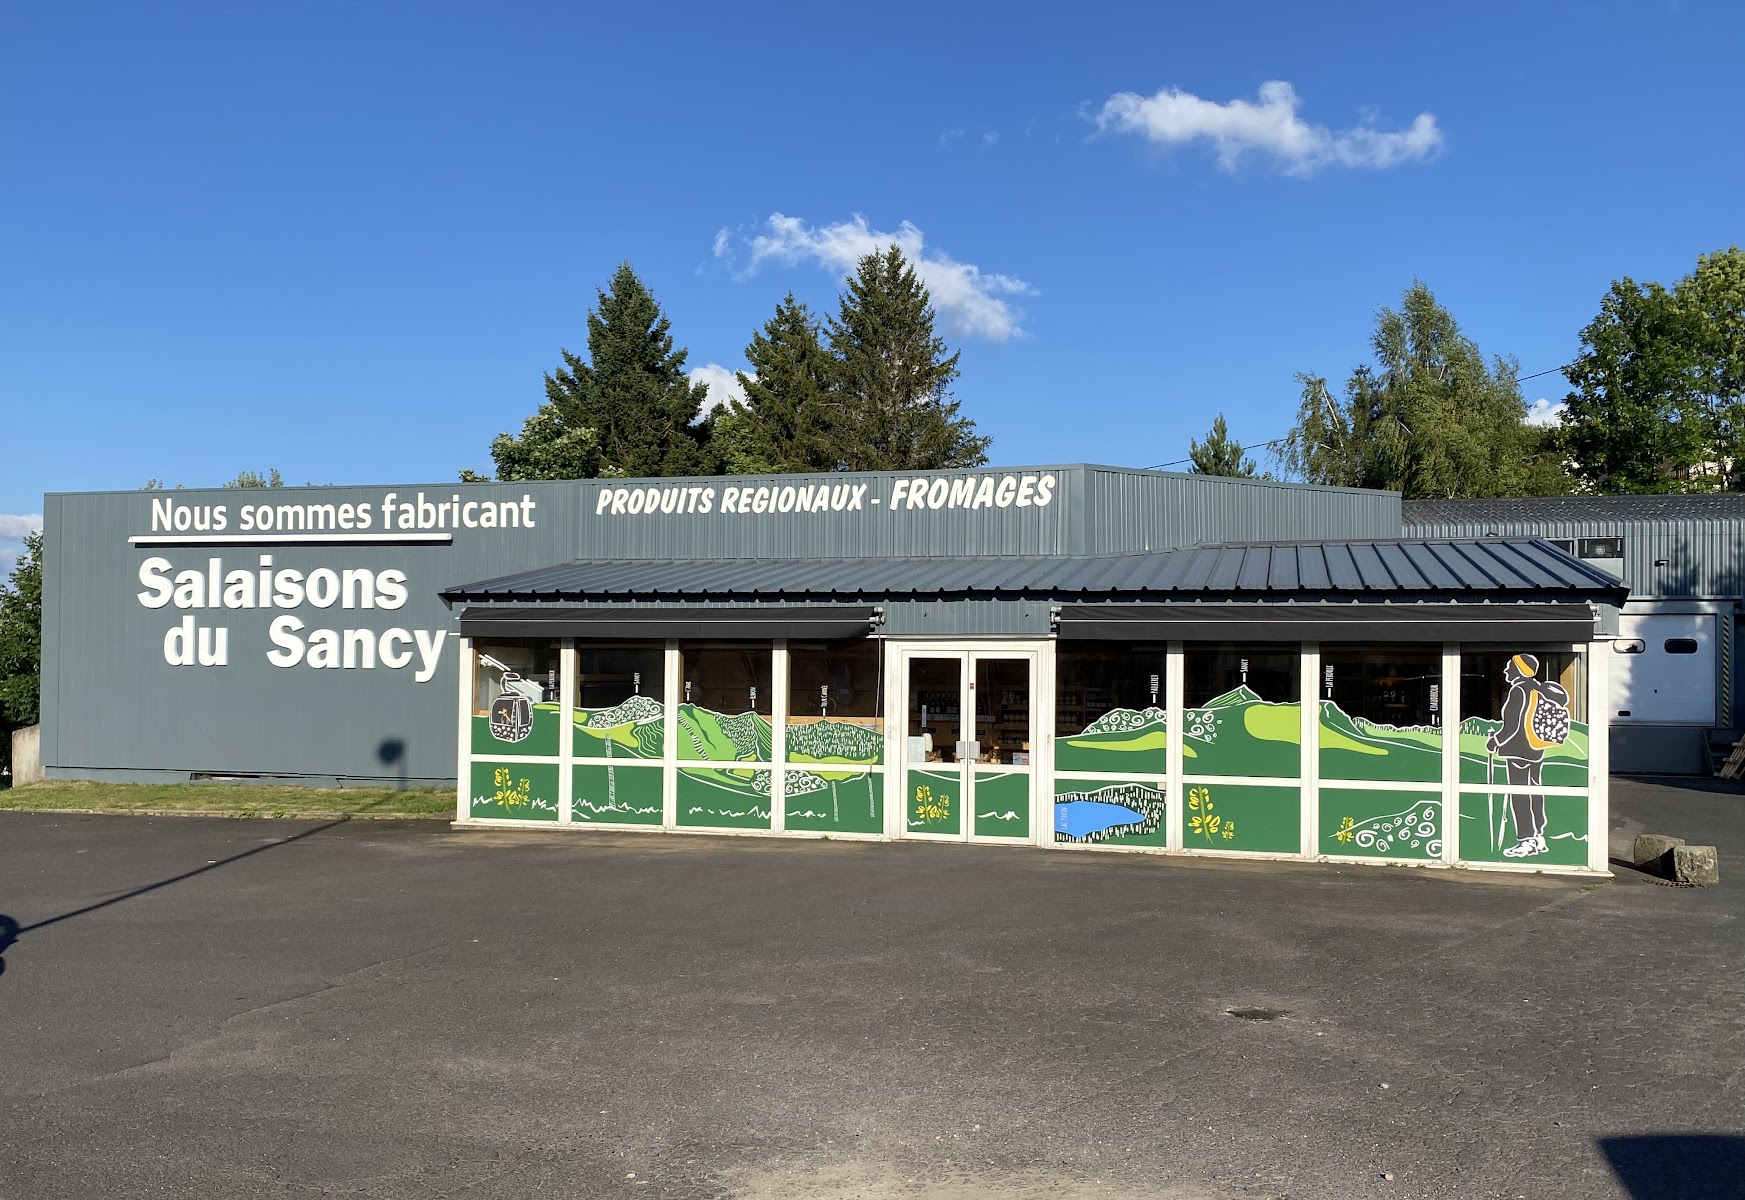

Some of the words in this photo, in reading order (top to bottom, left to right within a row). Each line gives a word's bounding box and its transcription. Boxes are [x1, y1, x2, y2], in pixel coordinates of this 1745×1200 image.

[152, 498, 227, 531] Nous
[240, 502, 371, 530] sommes
[382, 492, 535, 529] fabricant
[596, 488, 715, 515] PRODUITS
[721, 483, 867, 513] REGIONAUX
[890, 475, 1055, 510] FROMAGES
[138, 555, 408, 609] Salaisons
[164, 615, 228, 666] du
[267, 615, 446, 682] Sancy
[1240, 659, 1248, 673] SANCY
